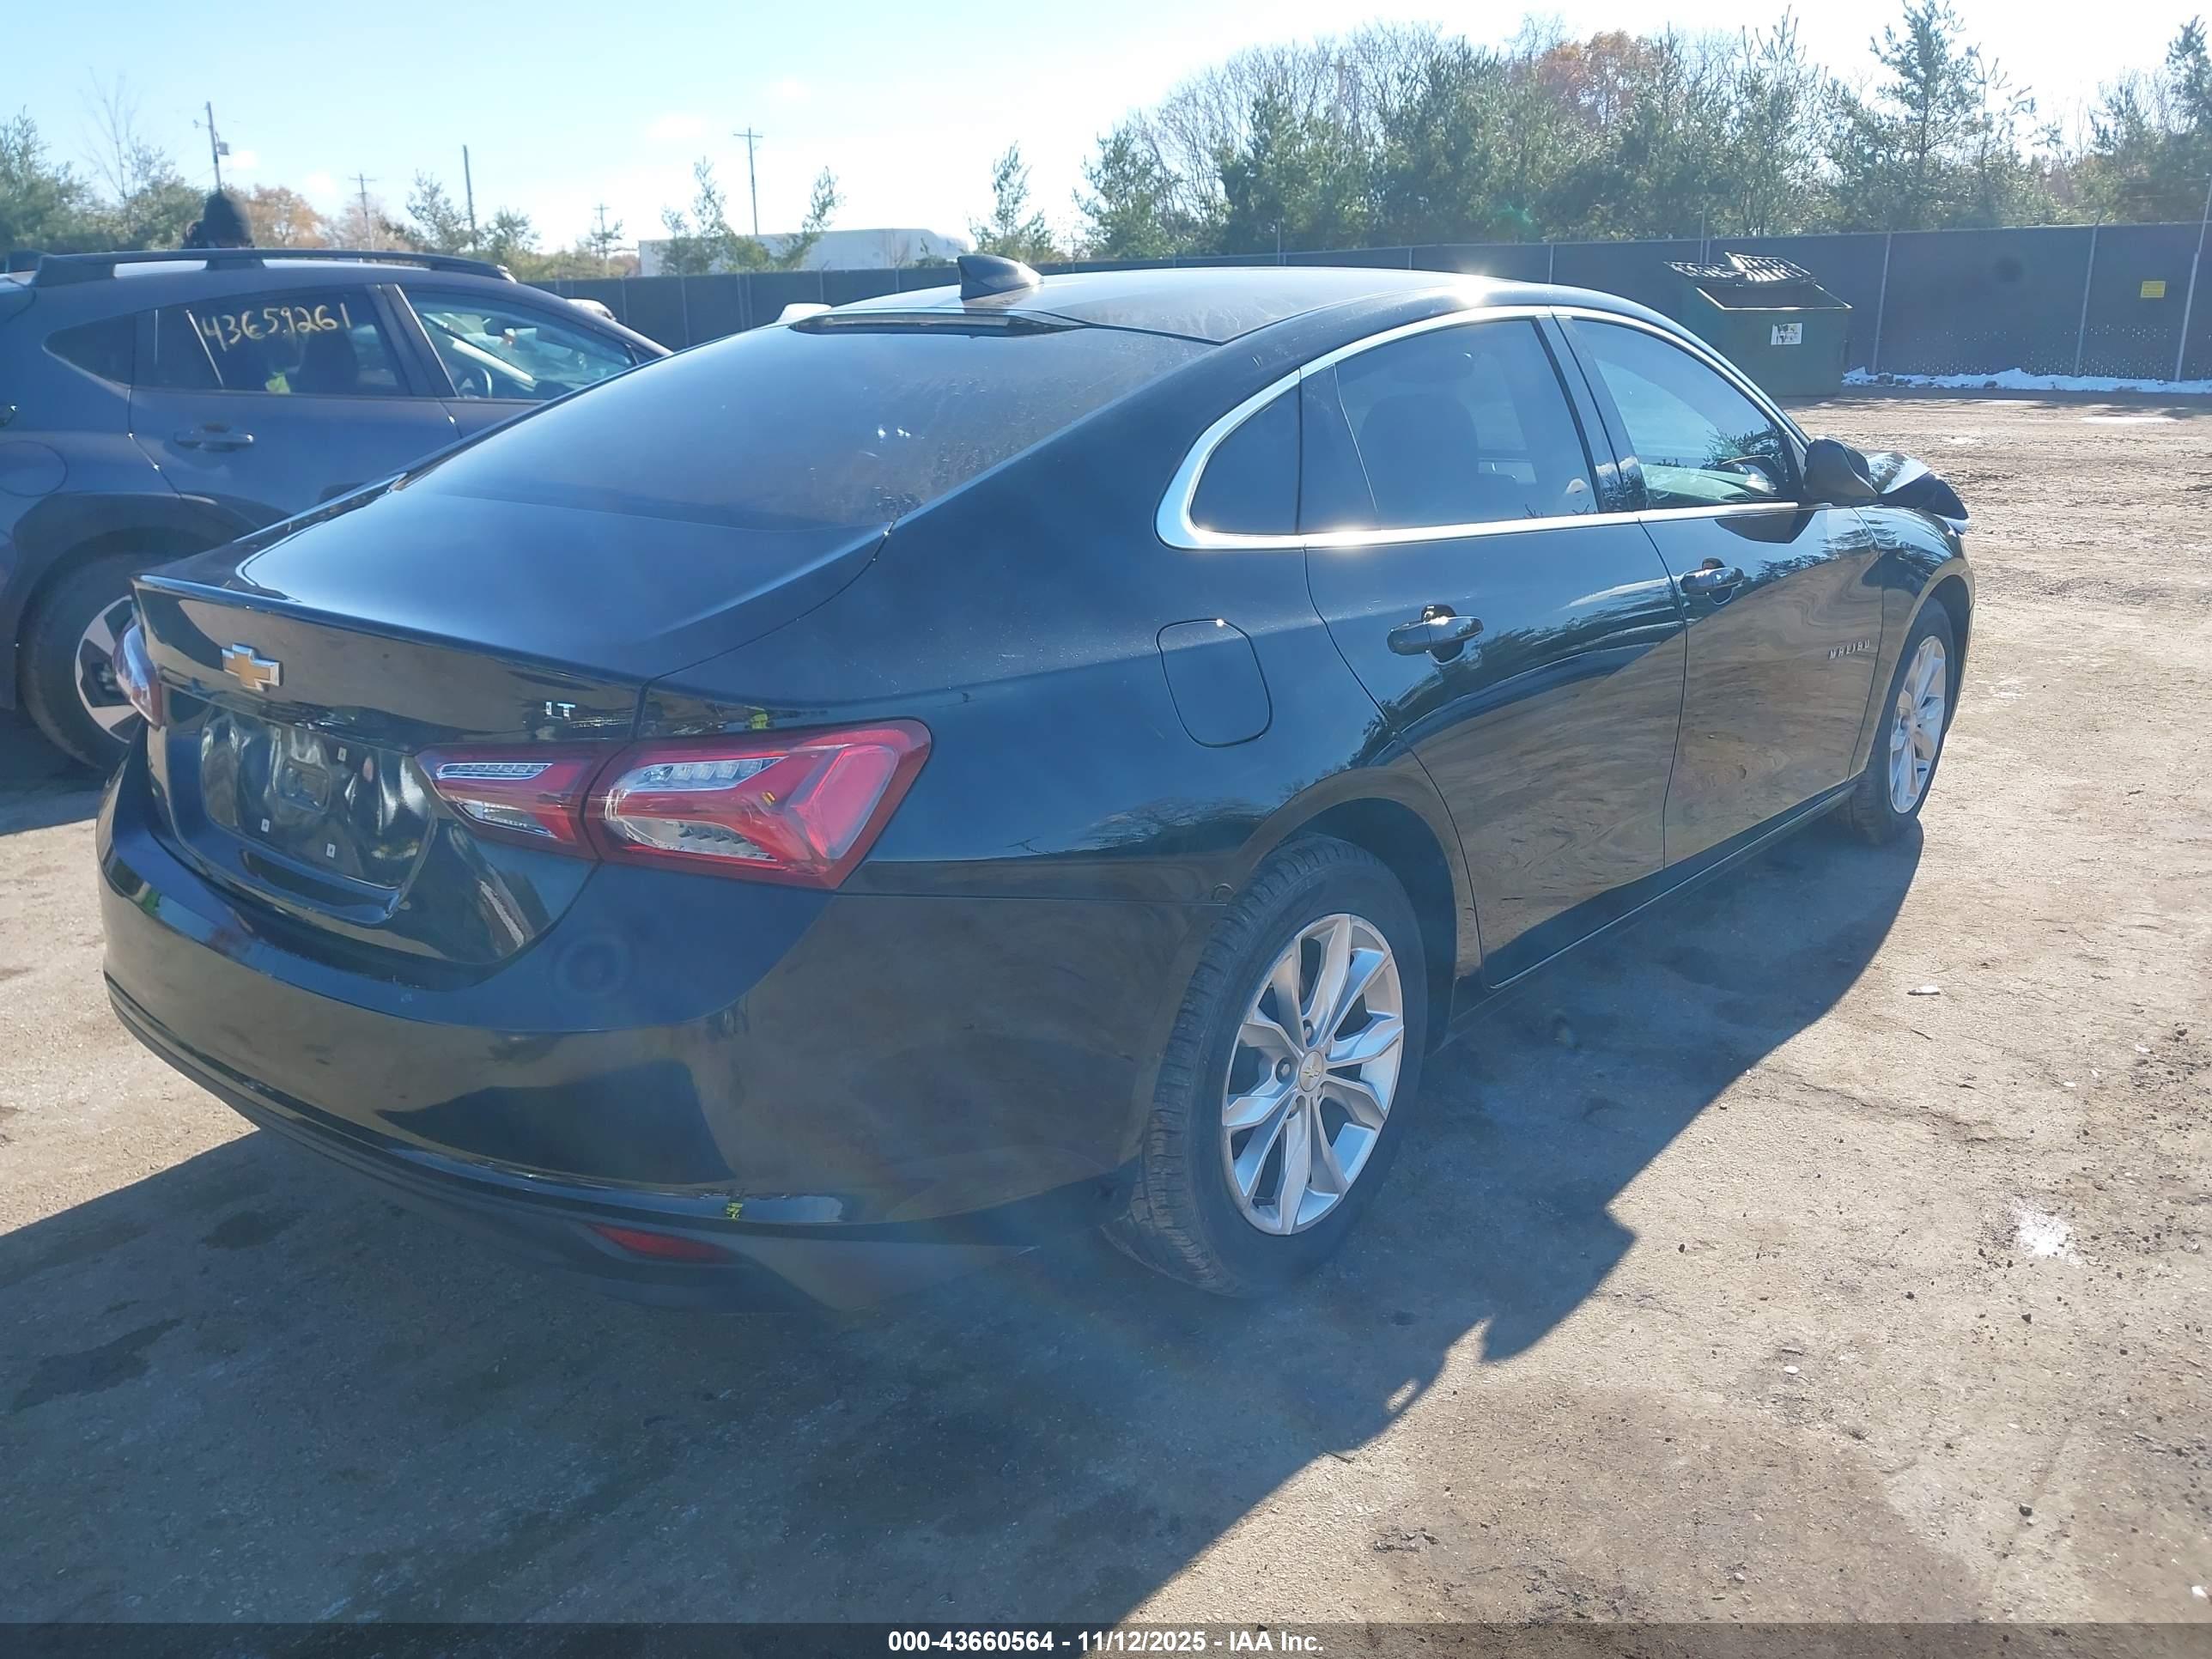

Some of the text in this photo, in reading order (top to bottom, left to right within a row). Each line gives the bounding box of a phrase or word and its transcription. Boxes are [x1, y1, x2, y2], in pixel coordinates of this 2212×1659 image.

[201, 301, 351, 352] 43659261
[1828, 639, 1870, 660] MALIBU
[544, 701, 577, 720] LT
